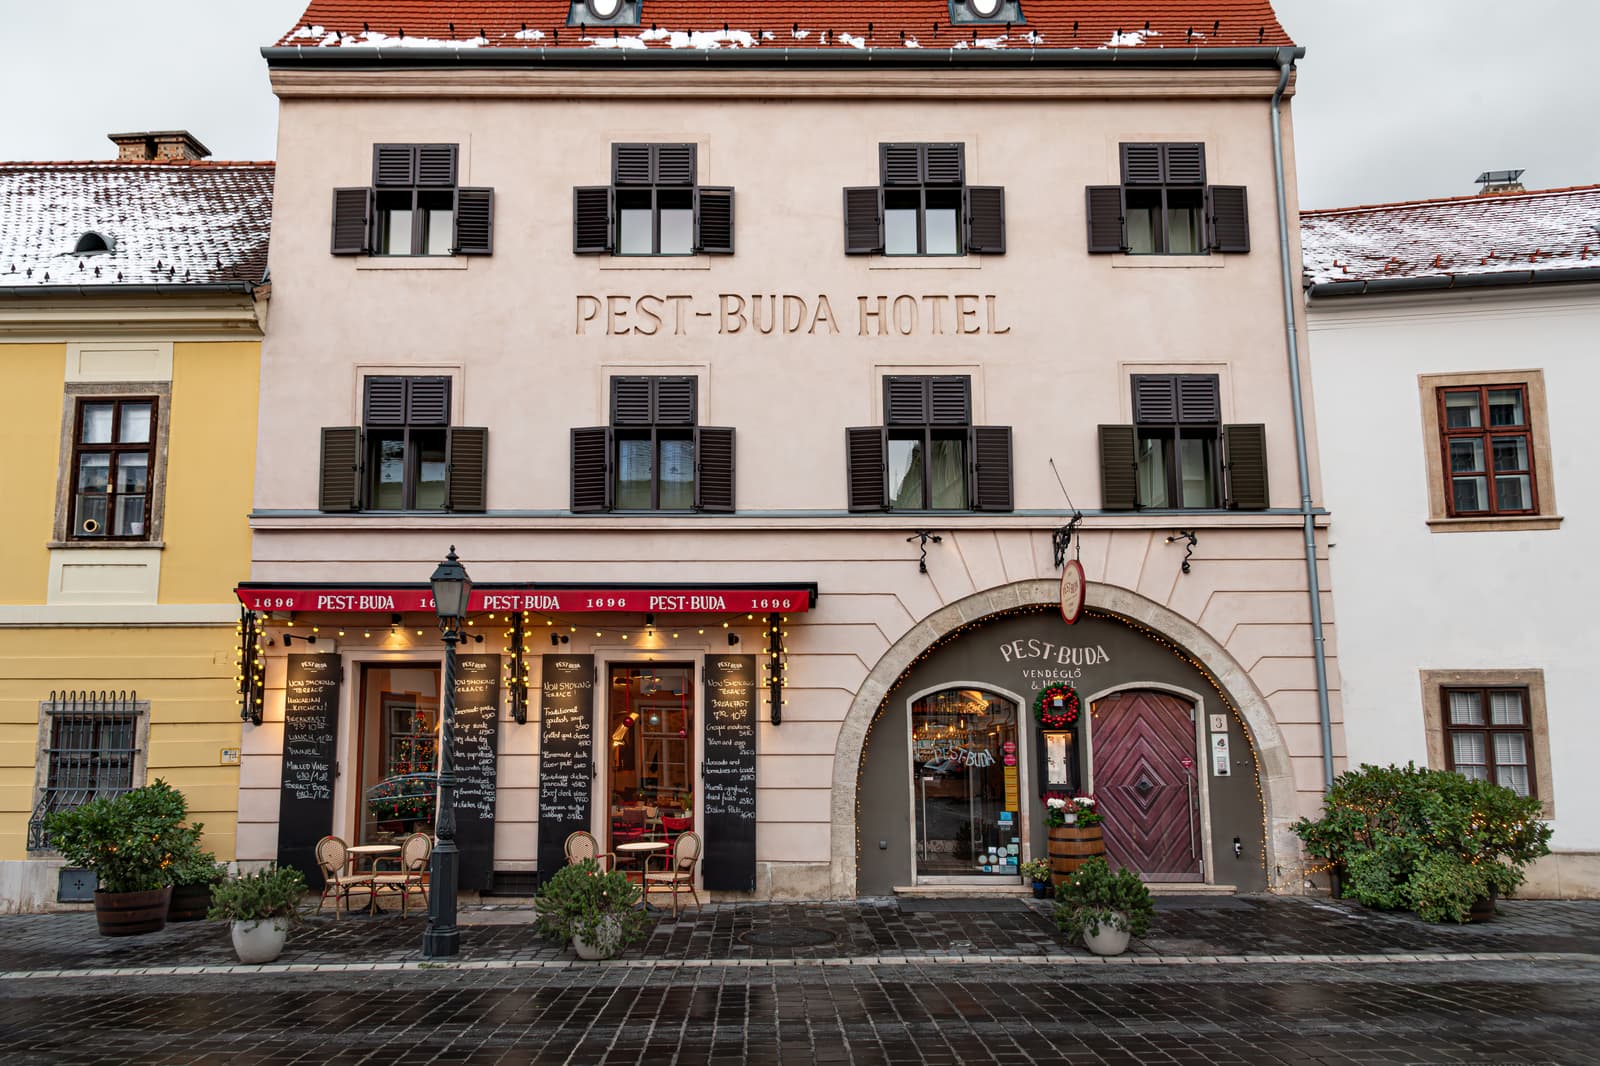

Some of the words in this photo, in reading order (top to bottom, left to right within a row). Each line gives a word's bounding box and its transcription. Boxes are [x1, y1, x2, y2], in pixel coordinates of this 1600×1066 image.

[575, 293, 840, 336] PEST-BUDA
[857, 294, 1011, 336] HOTEL
[254, 598, 294, 608] 1696
[586, 598, 626, 608] 1696
[751, 599, 791, 609] 1696
[1023, 668, 1082, 678] VENDÉGLŐ
[560, 681, 591, 690] SMOKING
[1031, 681, 1041, 690] &
[1043, 680, 1077, 689] HEL
